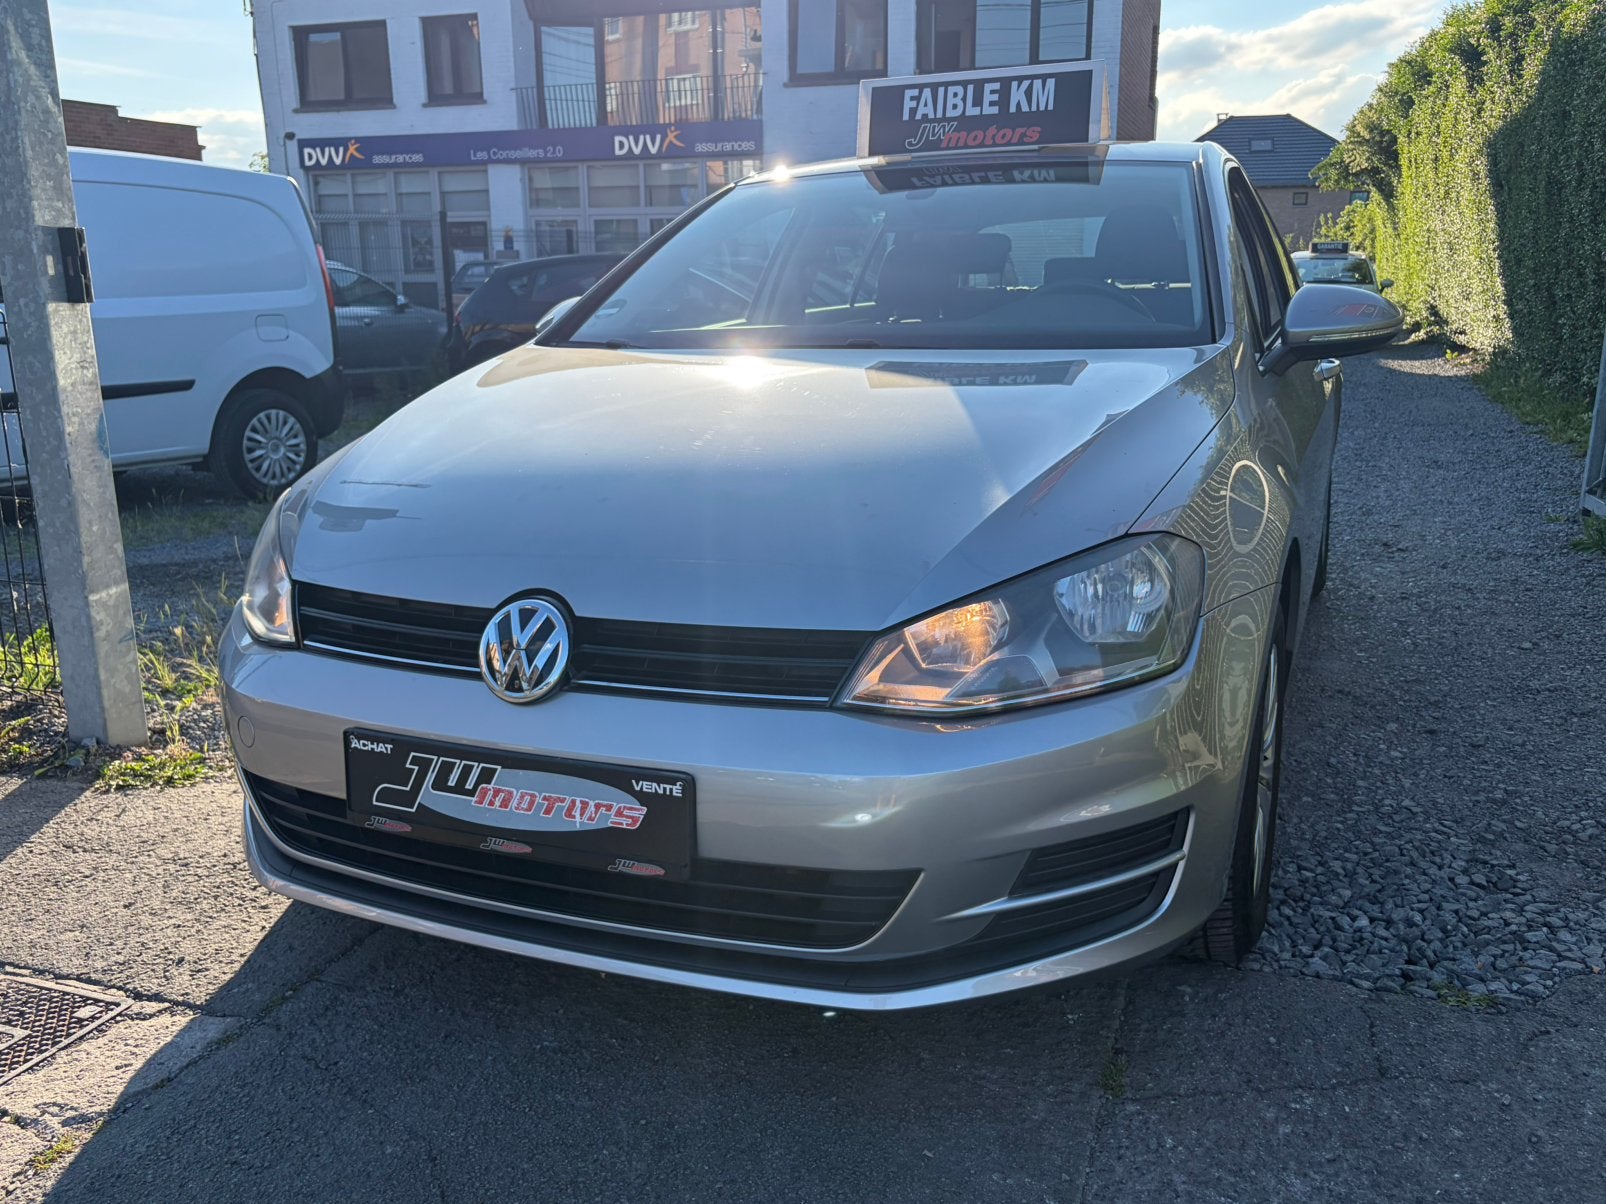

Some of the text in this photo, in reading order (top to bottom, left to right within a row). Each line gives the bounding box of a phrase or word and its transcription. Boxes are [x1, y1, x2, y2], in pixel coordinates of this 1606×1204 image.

[903, 78, 1056, 121] FAIBLE KM
[614, 134, 755, 155] DVV assurances
[905, 122, 1041, 150] JW motors
[303, 146, 424, 167] DVV assurances
[470, 145, 564, 161] Les Conseillers 2.0
[350, 736, 393, 755] ACHAT
